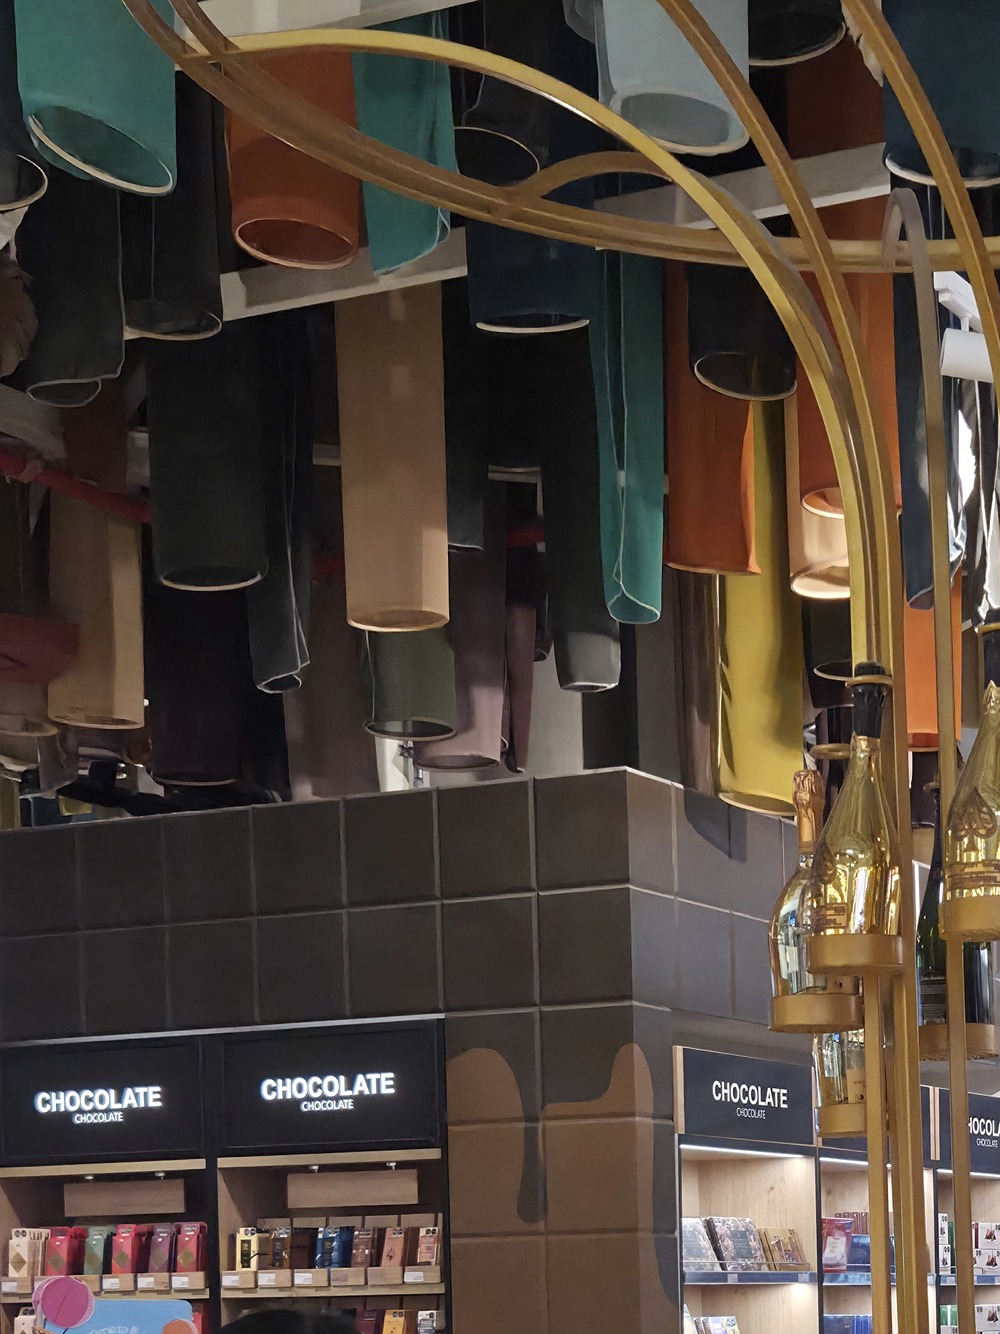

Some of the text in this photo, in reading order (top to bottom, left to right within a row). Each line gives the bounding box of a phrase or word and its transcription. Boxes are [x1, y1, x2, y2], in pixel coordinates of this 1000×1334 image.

[261, 1072, 396, 1101] CHOCOLATE
[712, 1080, 788, 1109] CHOCOLATE
[35, 1086, 162, 1114] CHOCOLATE
[301, 1098, 354, 1112] CHOCOLATE
[74, 1112, 123, 1124] CHOCOLATE
[736, 1107, 766, 1120] CHOCOLATE
